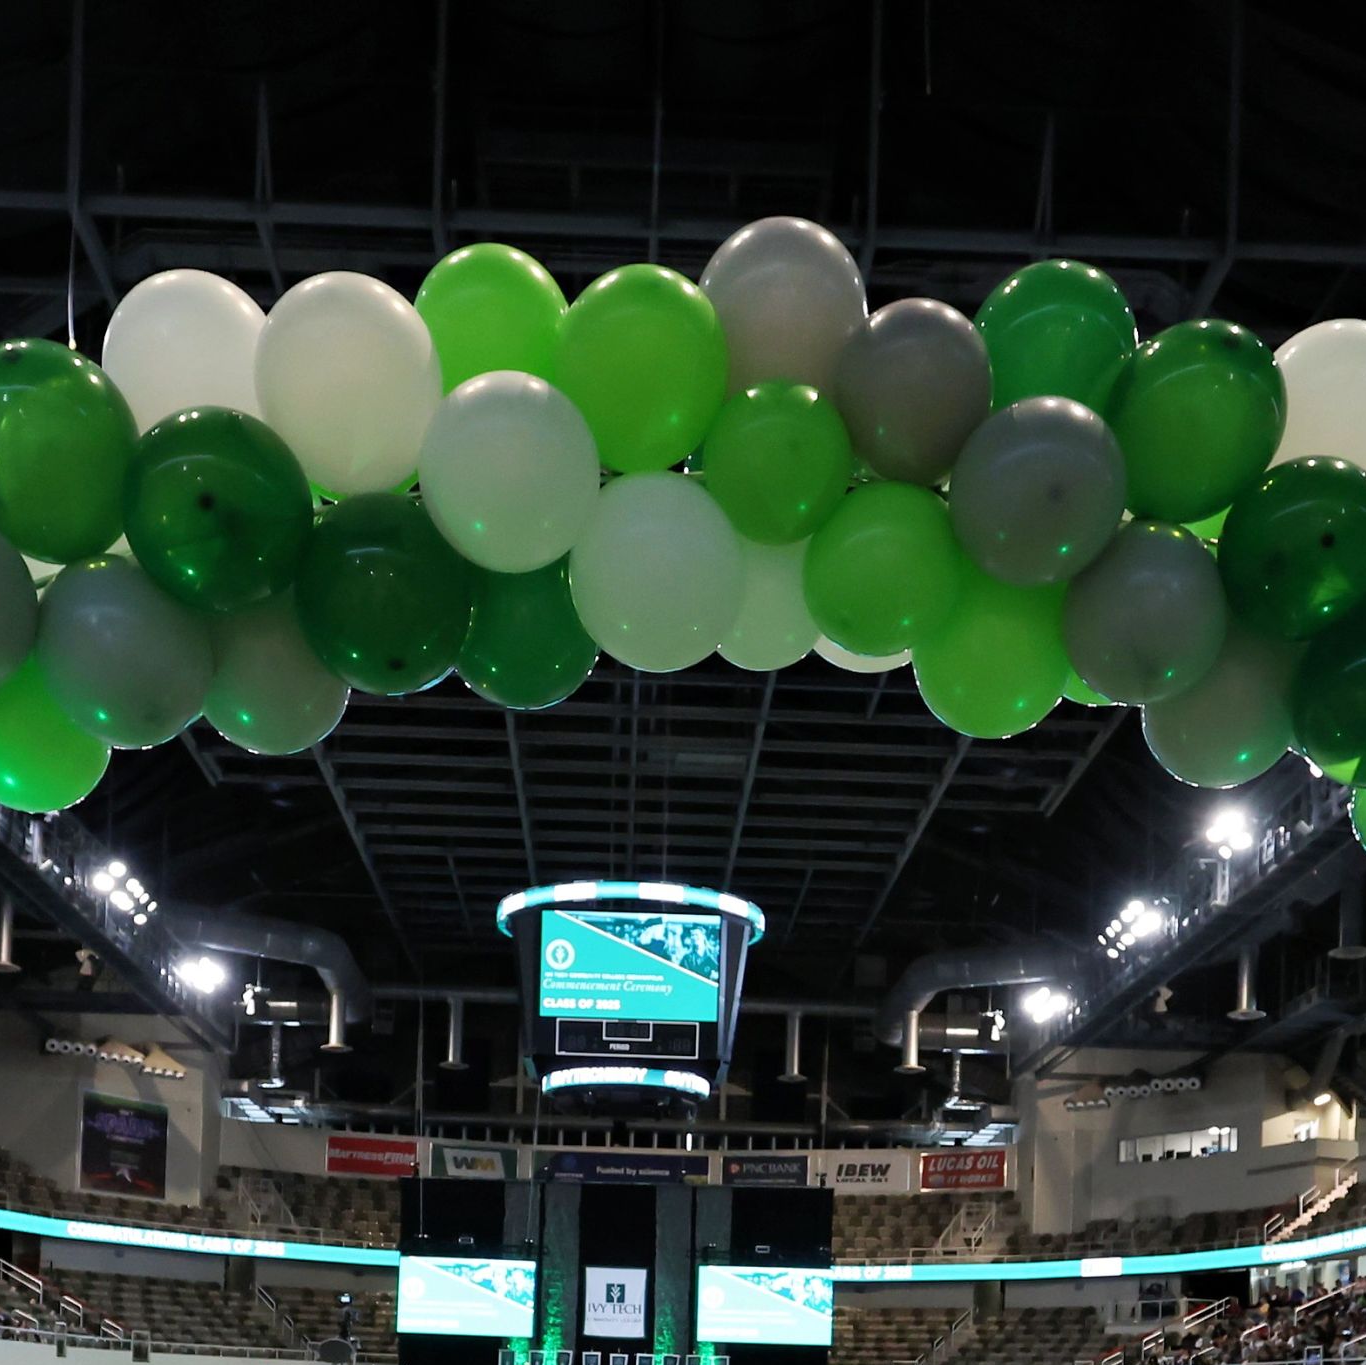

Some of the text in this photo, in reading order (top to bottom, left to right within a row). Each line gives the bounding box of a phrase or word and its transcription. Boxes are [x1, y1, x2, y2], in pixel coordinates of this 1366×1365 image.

[543, 997, 576, 1009] CLASS
[578, 998, 594, 1009] OF
[928, 1154, 999, 1172] LUCAS OIL
[837, 1163, 891, 1177] IBEW
[588, 1302, 642, 1315] IVY TECH
